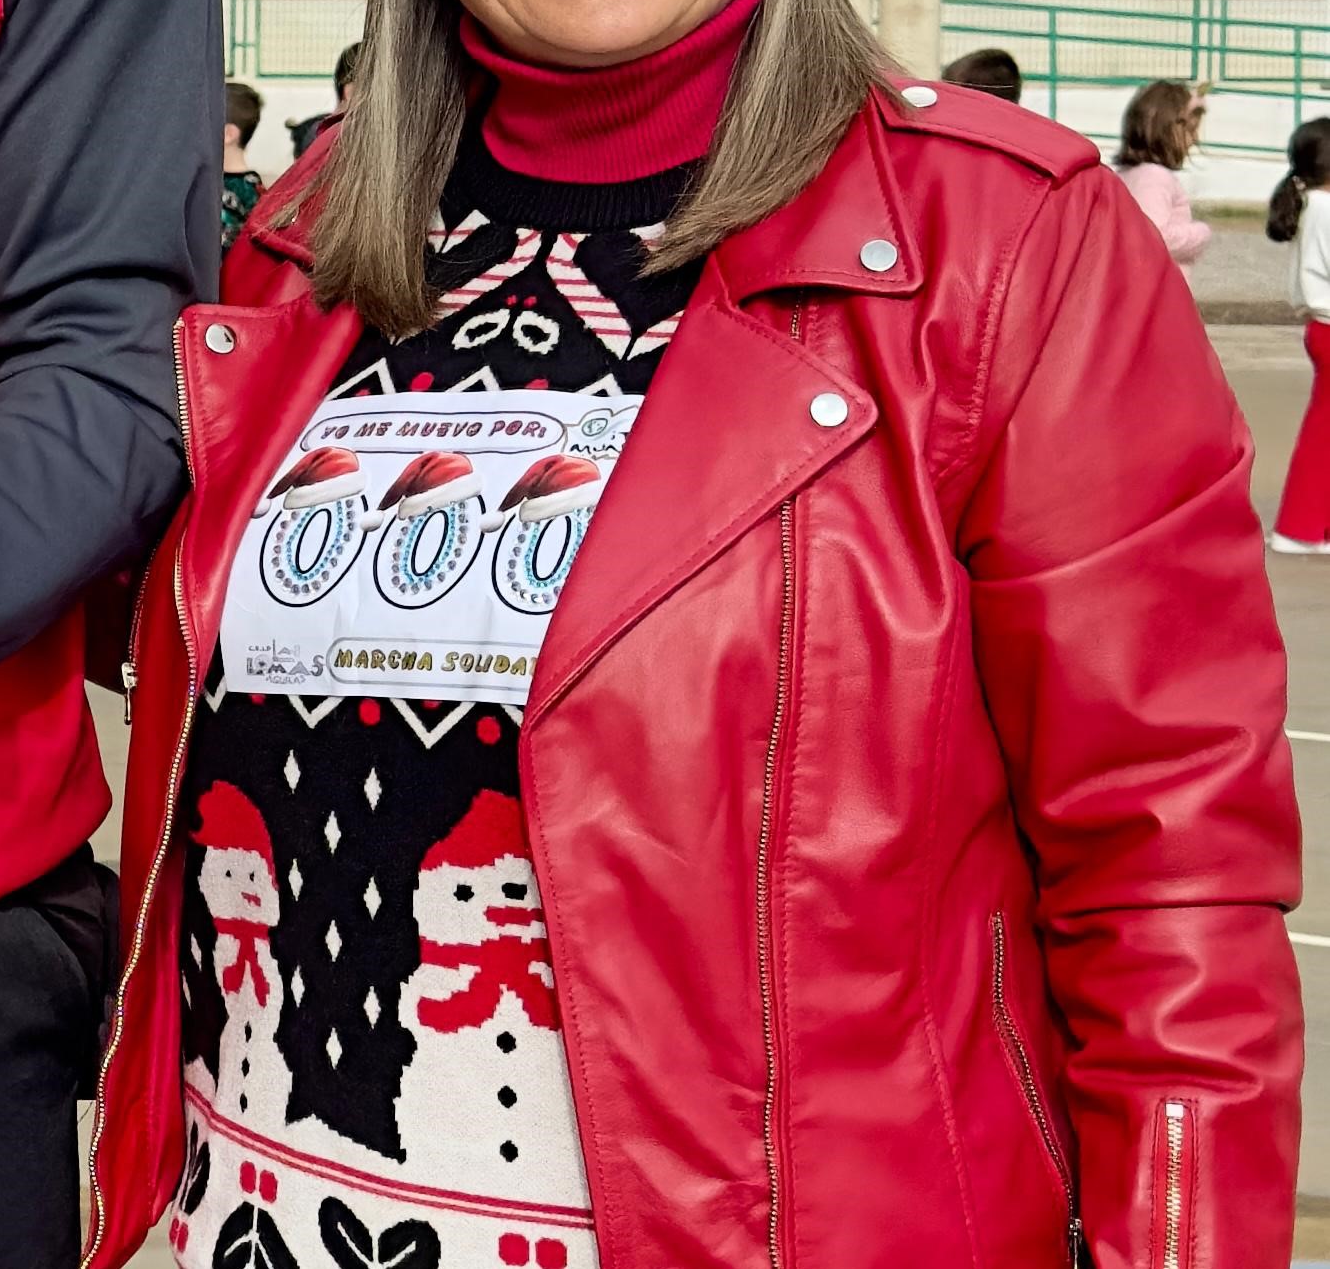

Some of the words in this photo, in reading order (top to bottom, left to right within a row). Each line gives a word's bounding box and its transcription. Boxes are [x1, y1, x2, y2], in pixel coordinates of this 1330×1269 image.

[321, 425, 350, 440] YO
[353, 422, 392, 438] ME
[395, 421, 483, 438] MUEVO
[488, 420, 547, 439] POR:
[334, 649, 432, 671] MARCHA
[441, 651, 537, 676] SOLIDA
